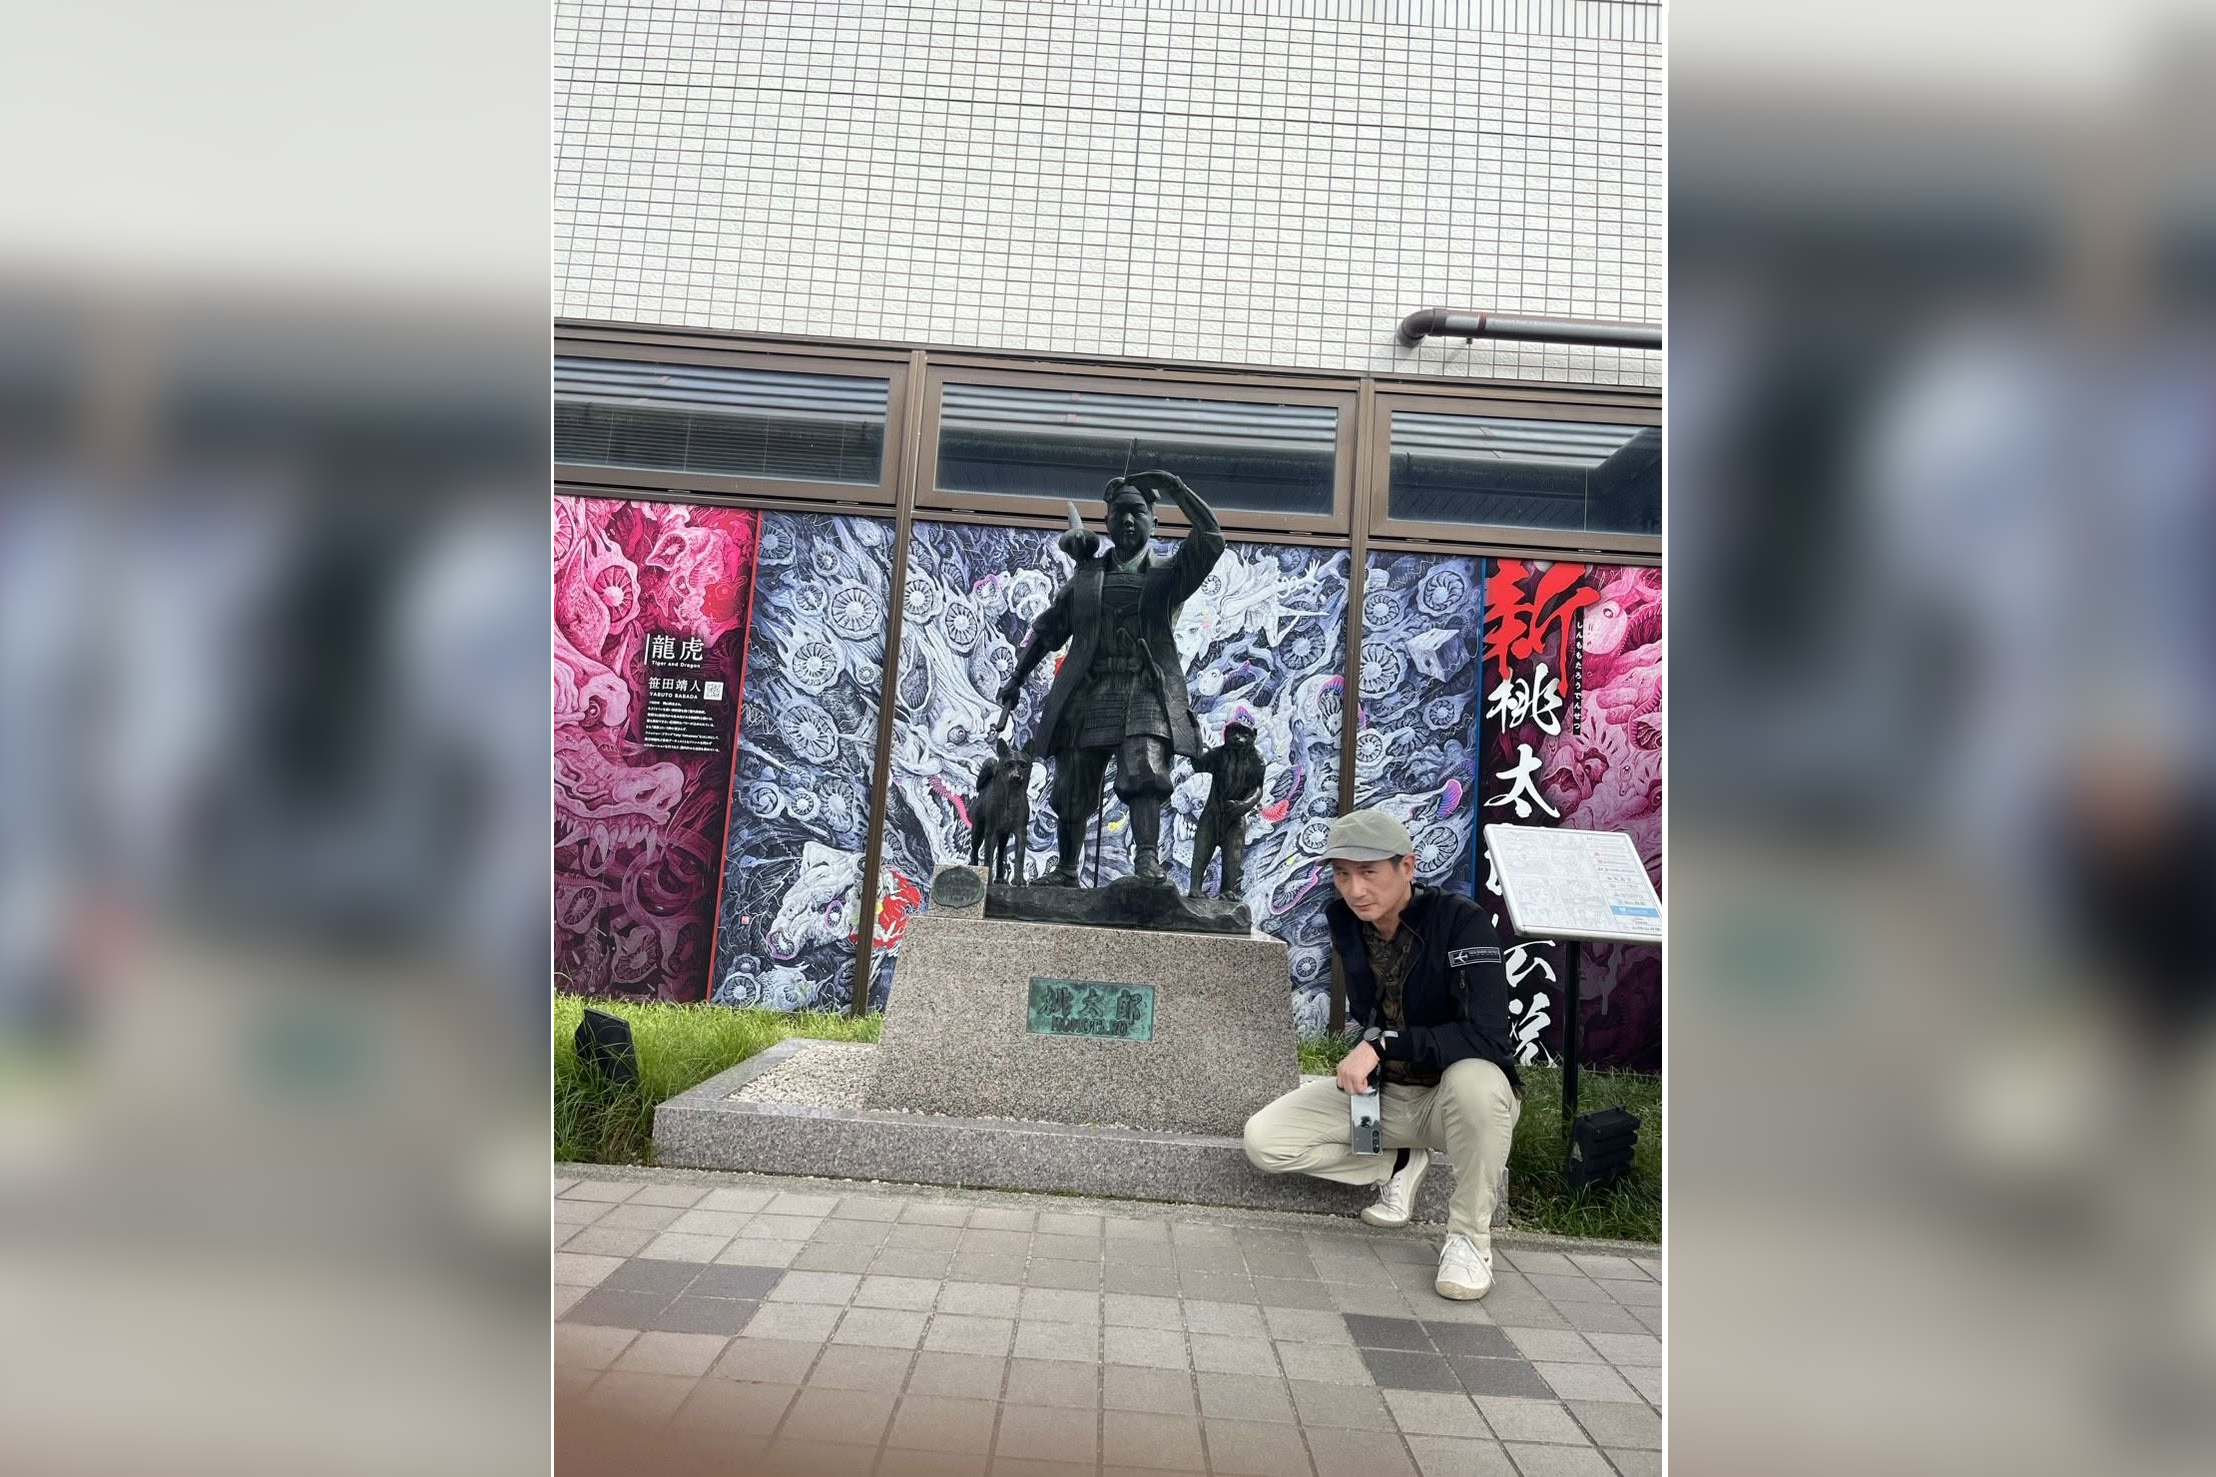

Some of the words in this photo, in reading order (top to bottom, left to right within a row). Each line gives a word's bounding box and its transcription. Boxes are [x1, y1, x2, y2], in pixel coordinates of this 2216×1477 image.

[652, 634, 704, 661] 龍虎
[649, 676, 701, 692] 笹田靖人
[1574, 621, 1584, 730] しんももたろうでんせつ
[1037, 985, 1143, 1025] 桃太郎
